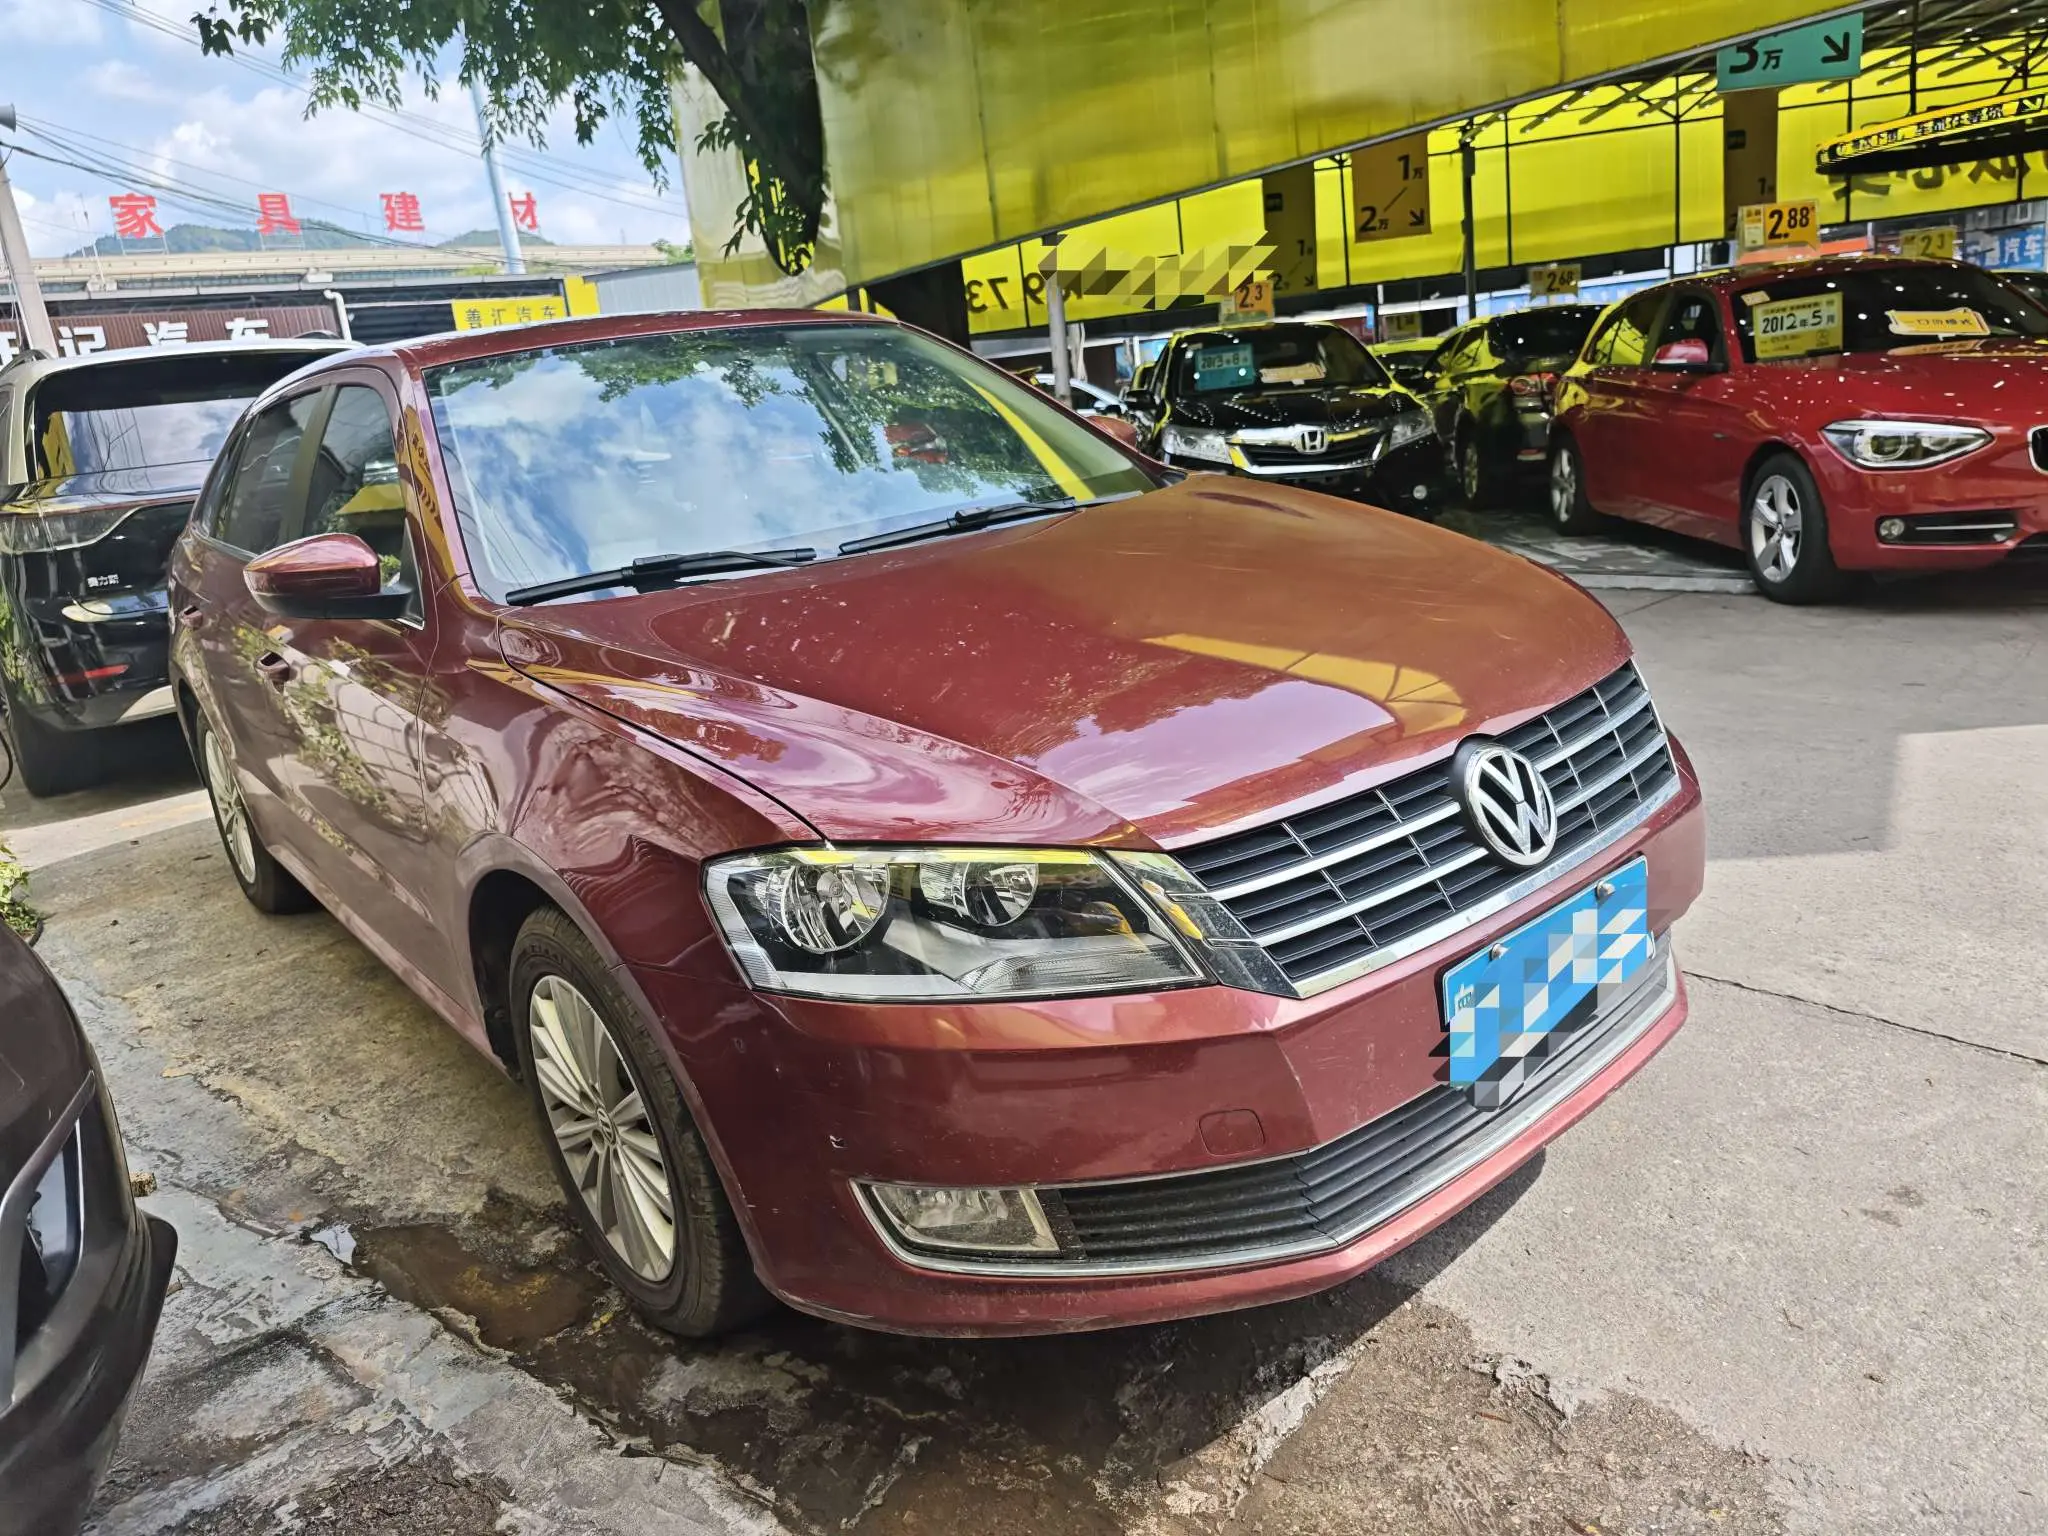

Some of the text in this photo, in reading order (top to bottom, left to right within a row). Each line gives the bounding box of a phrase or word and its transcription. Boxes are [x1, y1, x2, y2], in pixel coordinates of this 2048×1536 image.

[1398, 154, 1425, 181] 1万
[109, 192, 539, 240] 家具建材
[1359, 206, 1389, 232] 2万
[1768, 206, 1810, 240] 2.88
